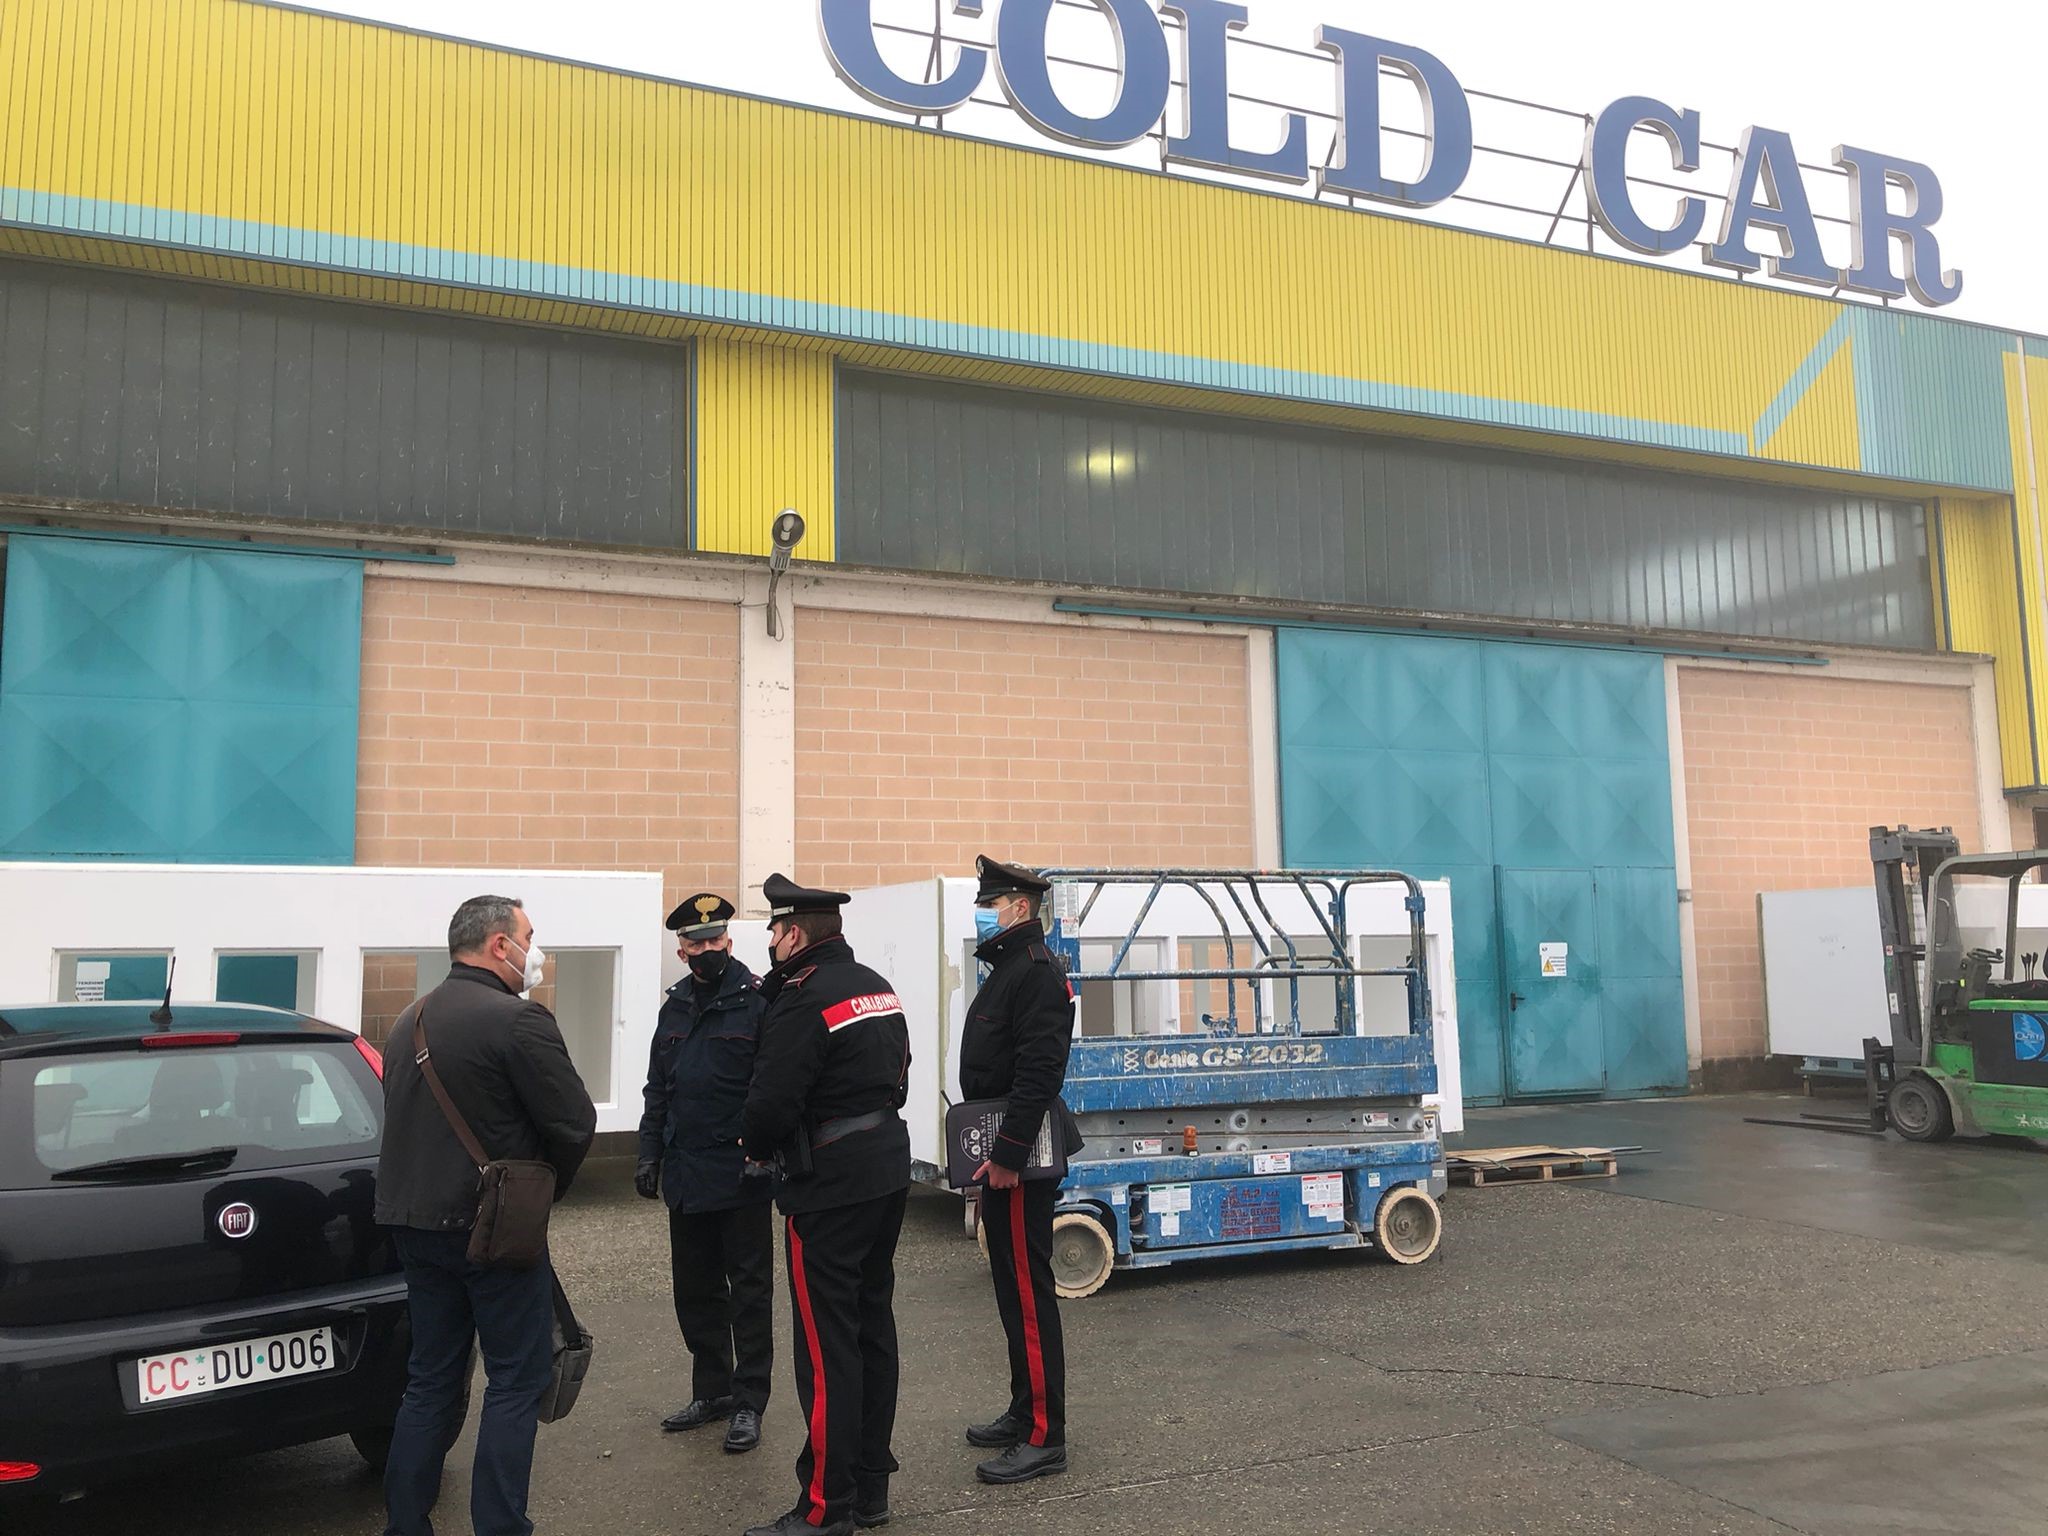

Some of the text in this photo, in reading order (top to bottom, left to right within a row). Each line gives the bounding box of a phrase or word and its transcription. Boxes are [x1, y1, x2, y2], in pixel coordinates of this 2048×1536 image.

[816, 0, 1964, 308] COLD CAR
[1202, 1046, 1244, 1068] GS
[1250, 1043, 1324, 1065] 2032
[227, 1212, 249, 1230] FIAT
[146, 1333, 327, 1396] CC DU 006
